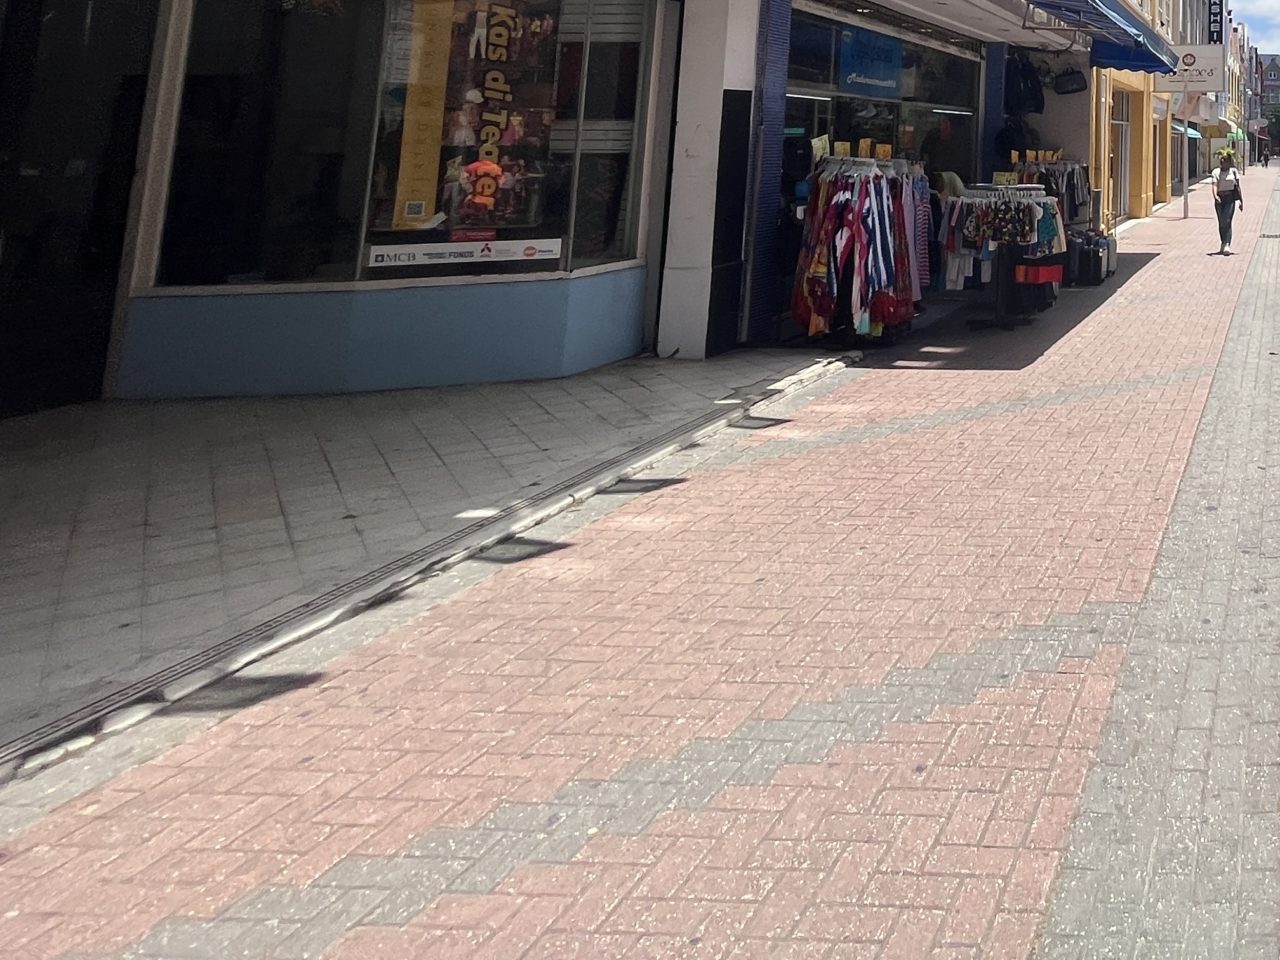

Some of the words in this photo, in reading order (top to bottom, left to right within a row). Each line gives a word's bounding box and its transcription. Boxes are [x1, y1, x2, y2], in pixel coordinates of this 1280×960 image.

[486, 4, 518, 63] Kas
[484, 69, 513, 102] di
[386, 252, 416, 262] MCB
